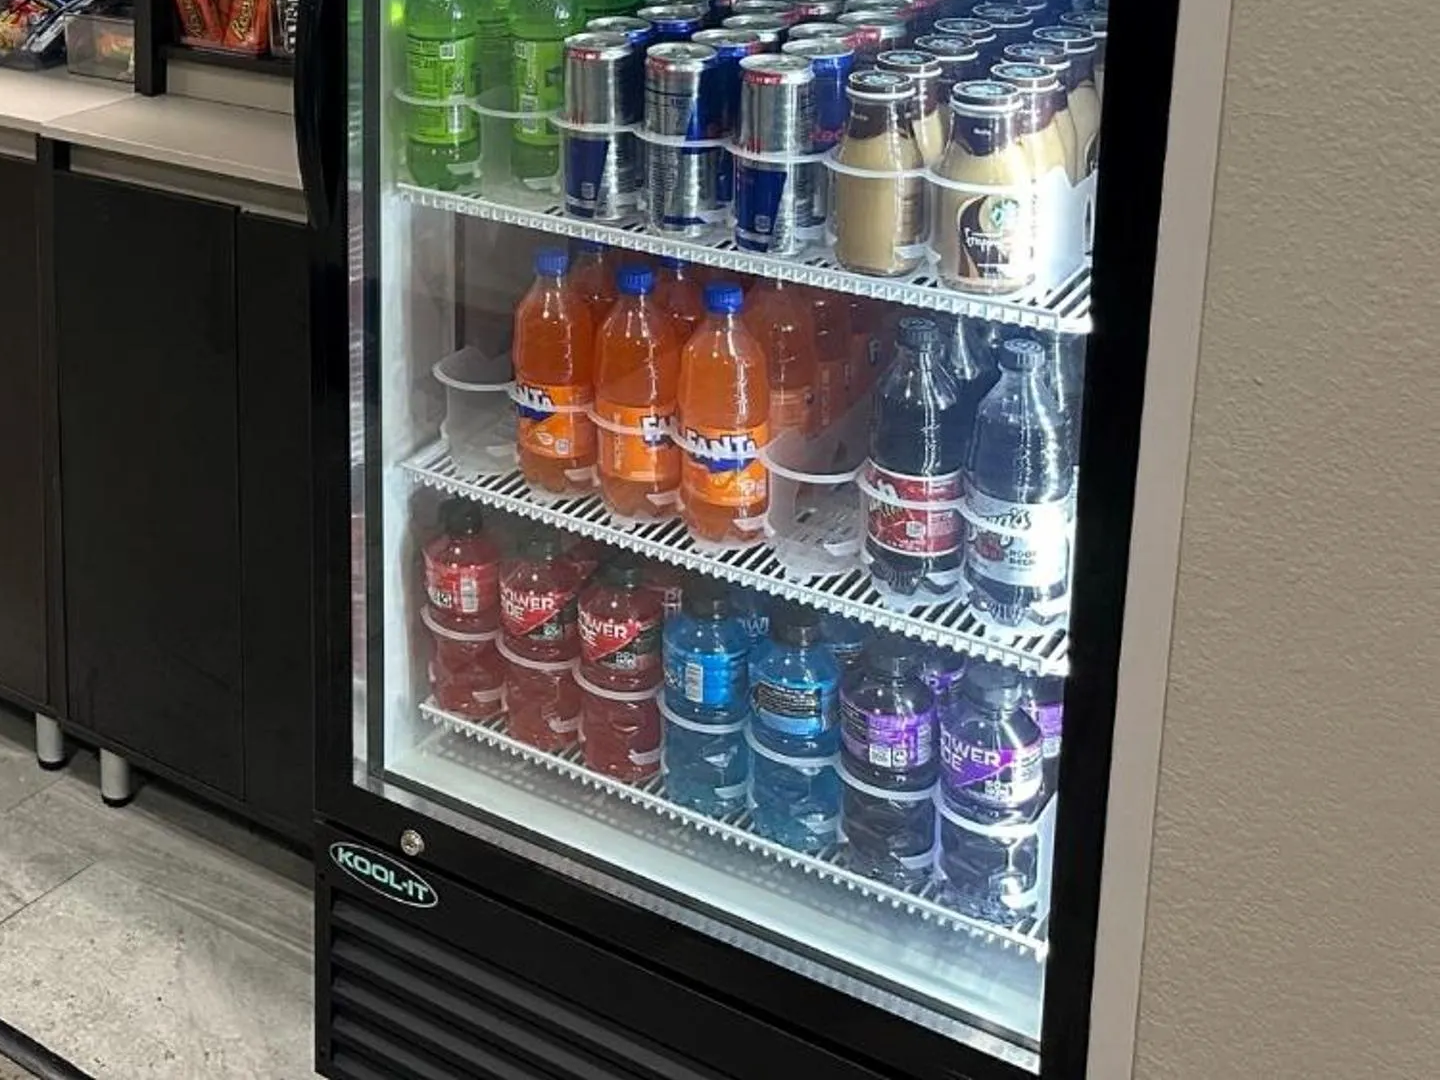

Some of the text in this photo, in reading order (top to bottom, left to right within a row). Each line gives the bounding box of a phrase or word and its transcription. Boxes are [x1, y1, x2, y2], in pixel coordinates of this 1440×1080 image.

[686, 427, 758, 462] FANTA
[940, 727, 1000, 767] OWER
[338, 846, 429, 902] KOOL-IT
